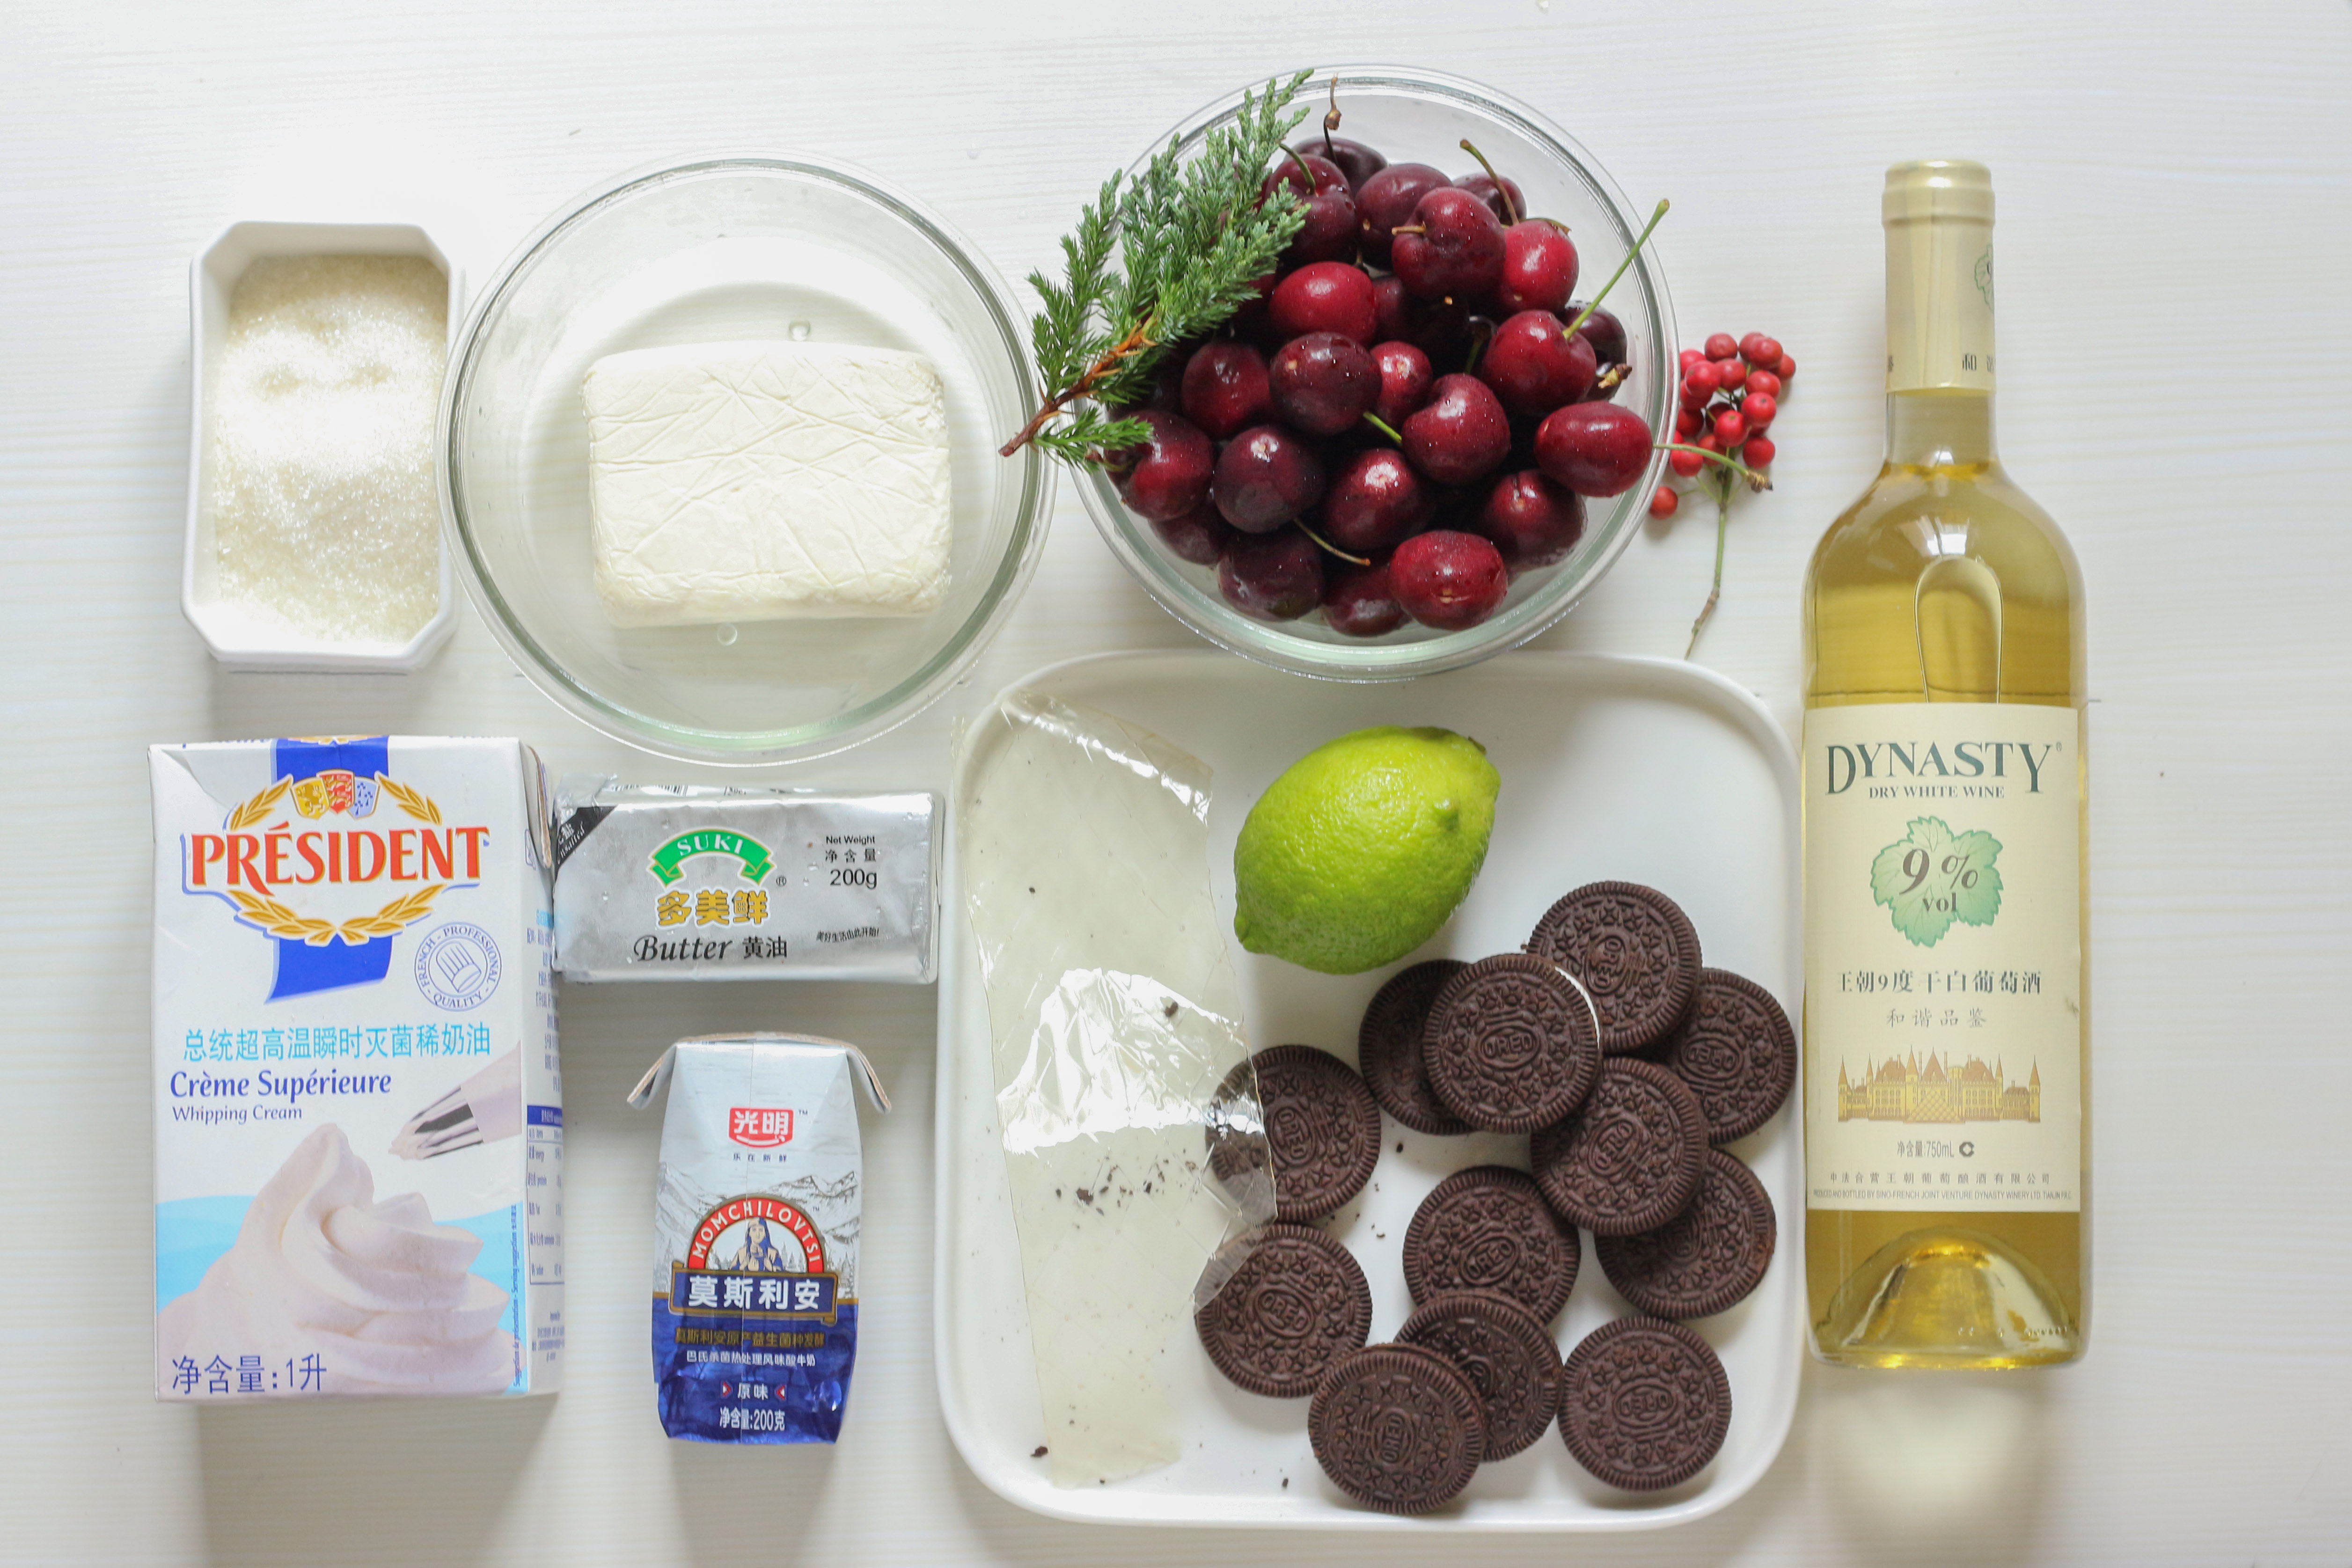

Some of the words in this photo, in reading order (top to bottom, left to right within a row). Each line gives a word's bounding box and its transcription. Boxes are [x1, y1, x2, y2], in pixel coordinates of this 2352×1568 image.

[1825, 740, 2053, 795] DYNASTY
[1869, 786, 1898, 799] DRY
[1904, 786, 1957, 798] WHITE
[1963, 786, 2004, 798] WINE
[677, 834, 743, 856] SUKI
[826, 835, 842, 844] Net
[844, 835, 876, 845] Weight
[191, 821, 490, 896] PRÉSIDENT
[825, 848, 876, 863] 净含量
[830, 869, 877, 889] 200g
[657, 890, 768, 925] 多美鲜
[1922, 892, 1956, 912] vol
[444, 925, 498, 983] PROFESSIONAL
[634, 936, 733, 961] Butter
[742, 936, 787, 959] 黄油
[418, 938, 435, 987] FRENCH
[1836, 968, 2041, 994] 王朝9度干白葡萄酒
[433, 990, 482, 1008] QUALITY
[1887, 1007, 1986, 1028] 和谐品鉴
[183, 1021, 490, 1062] 总统超高温瞬时灭菌稀奶油
[1484, 1034, 1532, 1056] OREO
[170, 1069, 249, 1098] Crème
[258, 1068, 391, 1103] Supérieure
[172, 1106, 247, 1125] Whipping
[252, 1104, 303, 1121] Cream
[734, 1110, 789, 1137] 光明
[733, 1152, 787, 1163] 乐在新鲜
[1867, 1189, 1874, 1199] BY
[1921, 1190, 1938, 1200] JOINT
[1942, 1190, 1971, 1200] VENTURE
[1974, 1190, 2004, 1200] DYNASTY
[2006, 1190, 2030, 1200] WINERY
[692, 1201, 821, 1263] MOMCHILOVTSI
[688, 1275, 820, 1310] 莫斯利安
[738, 1382, 768, 1400] 原味
[1381, 1415, 1403, 1463] OREO
